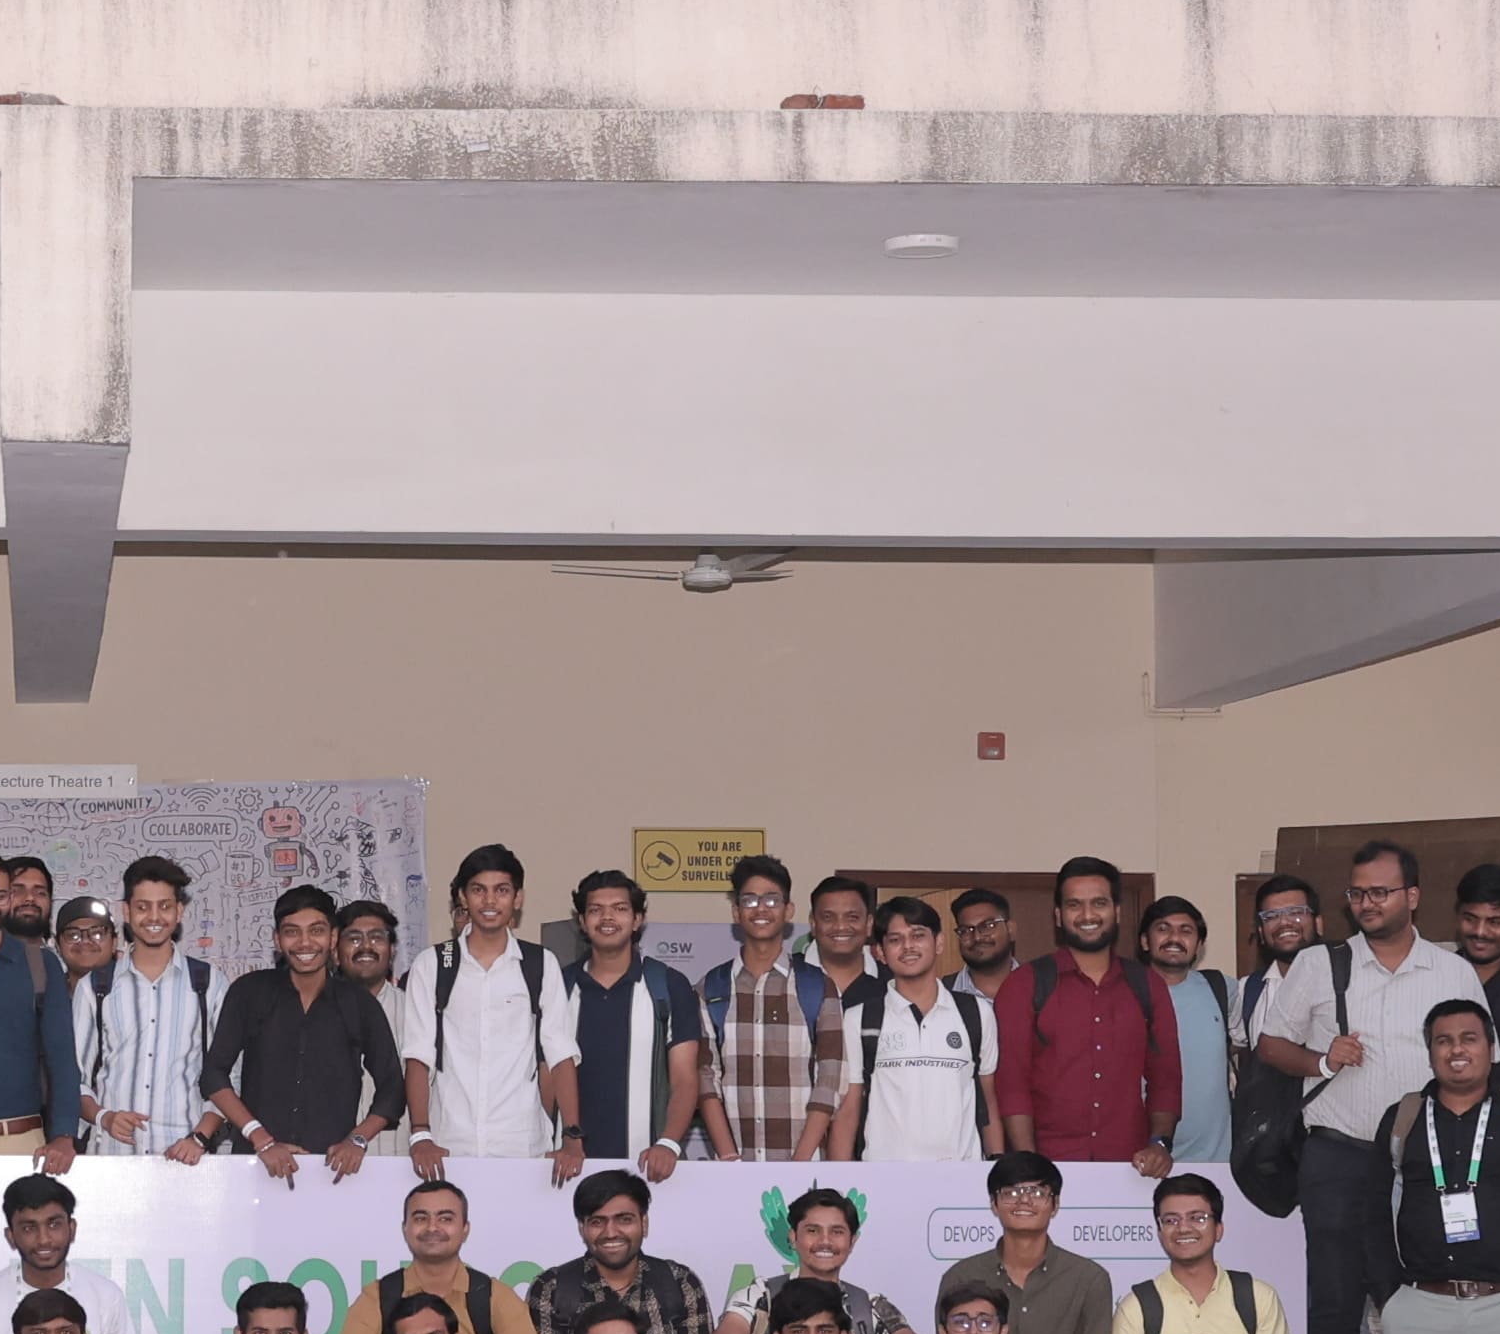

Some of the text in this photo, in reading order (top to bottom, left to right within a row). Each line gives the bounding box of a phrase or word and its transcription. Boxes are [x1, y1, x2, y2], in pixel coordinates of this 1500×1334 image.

[49, 775, 103, 788] Theatre
[107, 775, 113, 788] 1
[80, 797, 153, 815] COMMUNITY
[149, 823, 232, 837] COLLABORATE
[698, 841, 742, 852] YOU ARE
[687, 855, 722, 867] UNDER
[681, 869, 732, 881] SURVEILL
[944, 1224, 1154, 1243] DEVOPS DEVELOPERS
